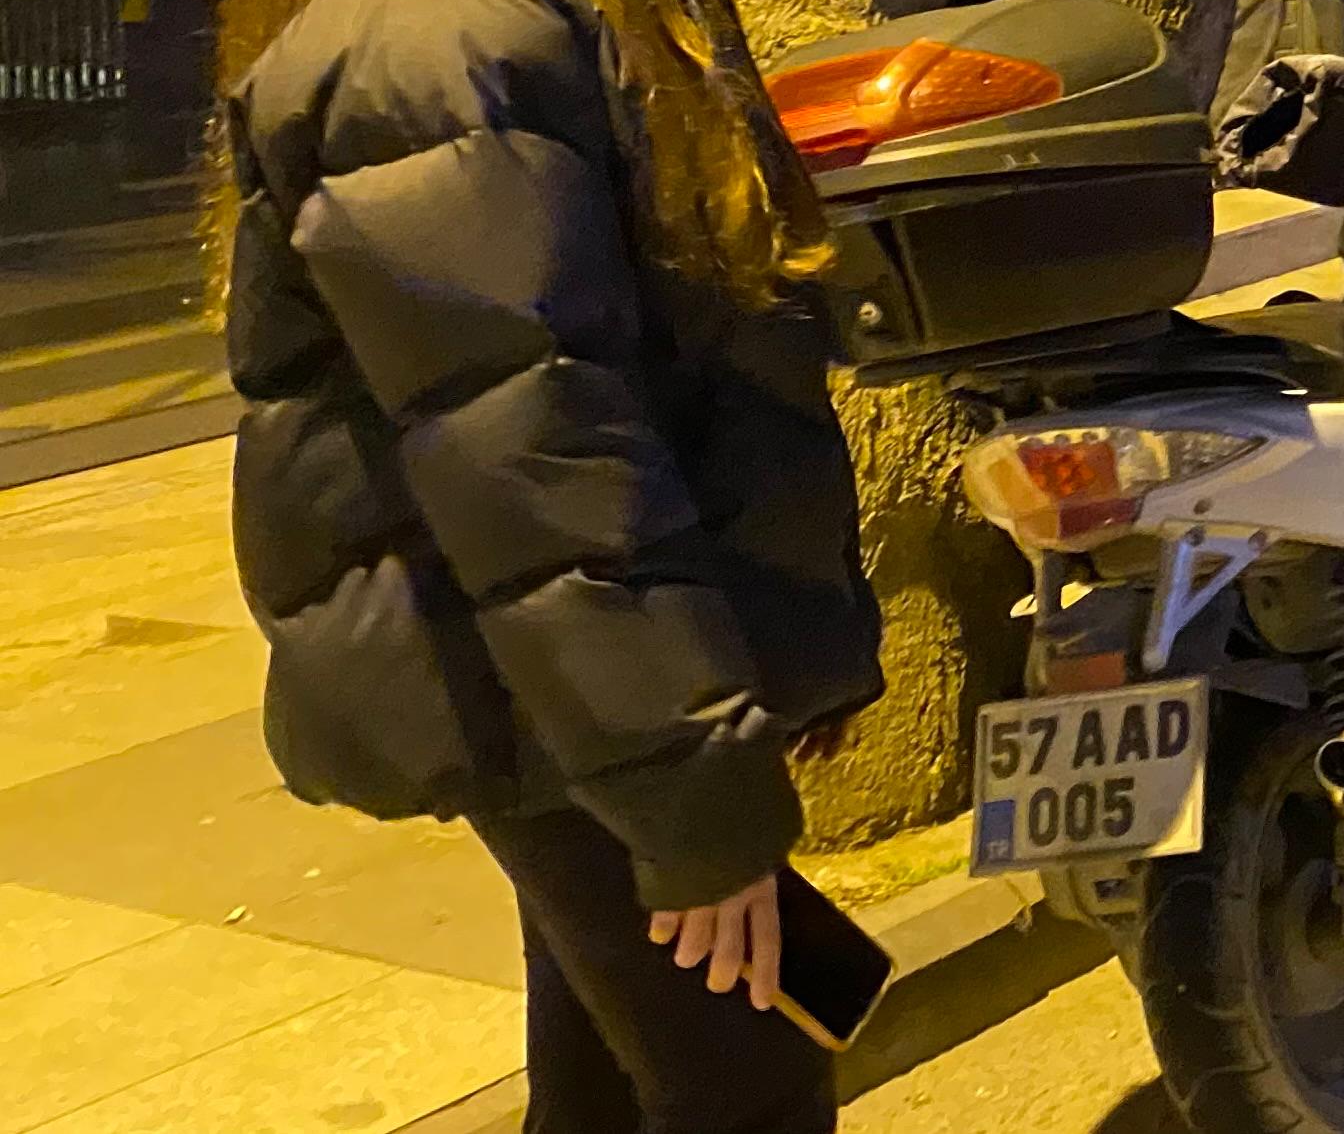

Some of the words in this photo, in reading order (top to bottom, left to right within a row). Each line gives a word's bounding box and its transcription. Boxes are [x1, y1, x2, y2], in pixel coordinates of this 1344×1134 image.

[990, 717, 1058, 780] 57
[1073, 699, 1190, 770] AAD
[1028, 777, 1135, 848] 005
